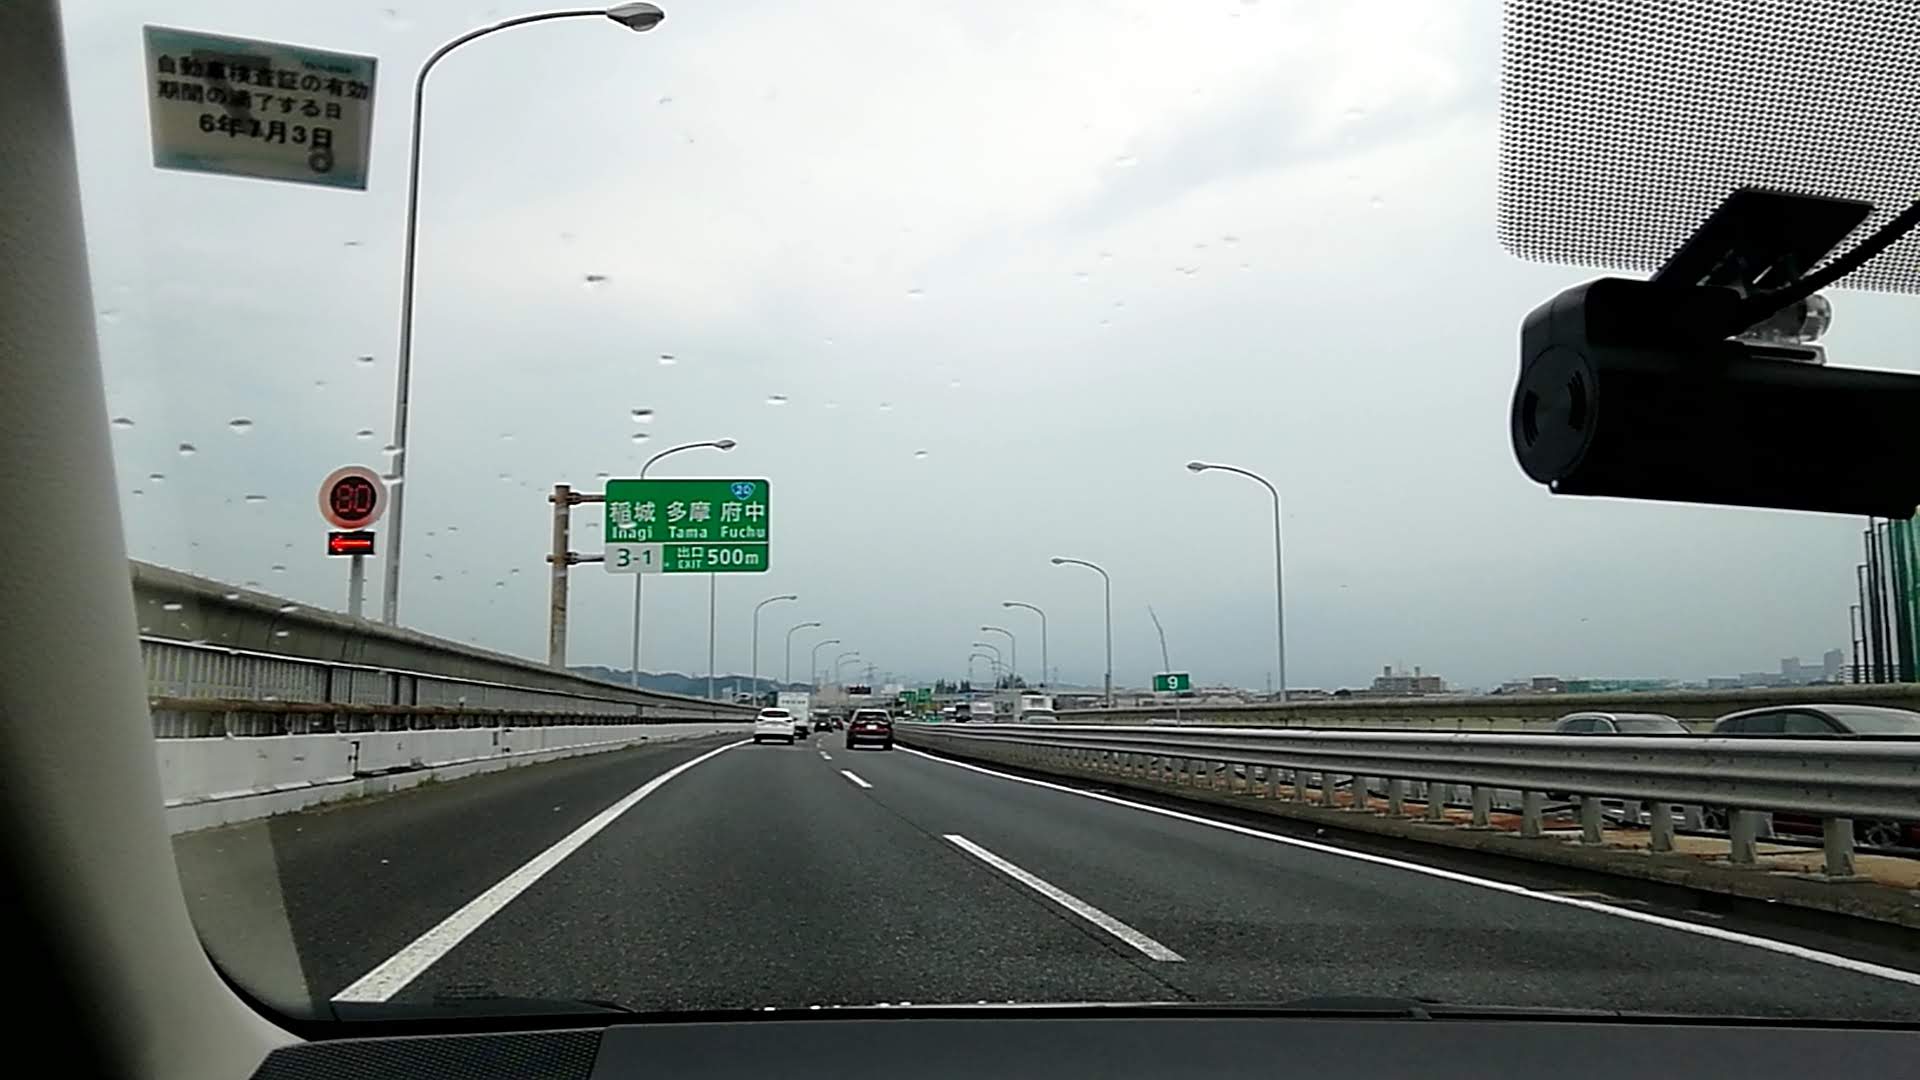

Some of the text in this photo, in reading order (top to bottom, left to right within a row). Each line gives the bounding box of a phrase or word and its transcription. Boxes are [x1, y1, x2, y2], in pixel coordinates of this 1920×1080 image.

[736, 484, 751, 495] 20
[336, 484, 371, 512] 80
[609, 501, 764, 522] 稲城 多摩 府中
[612, 526, 765, 541] Inagi Tama Fuchu
[616, 548, 651, 567] 3-1
[677, 547, 759, 565] 出口 500m
[678, 560, 702, 569] EXIT
[1167, 676, 1178, 689] 9
